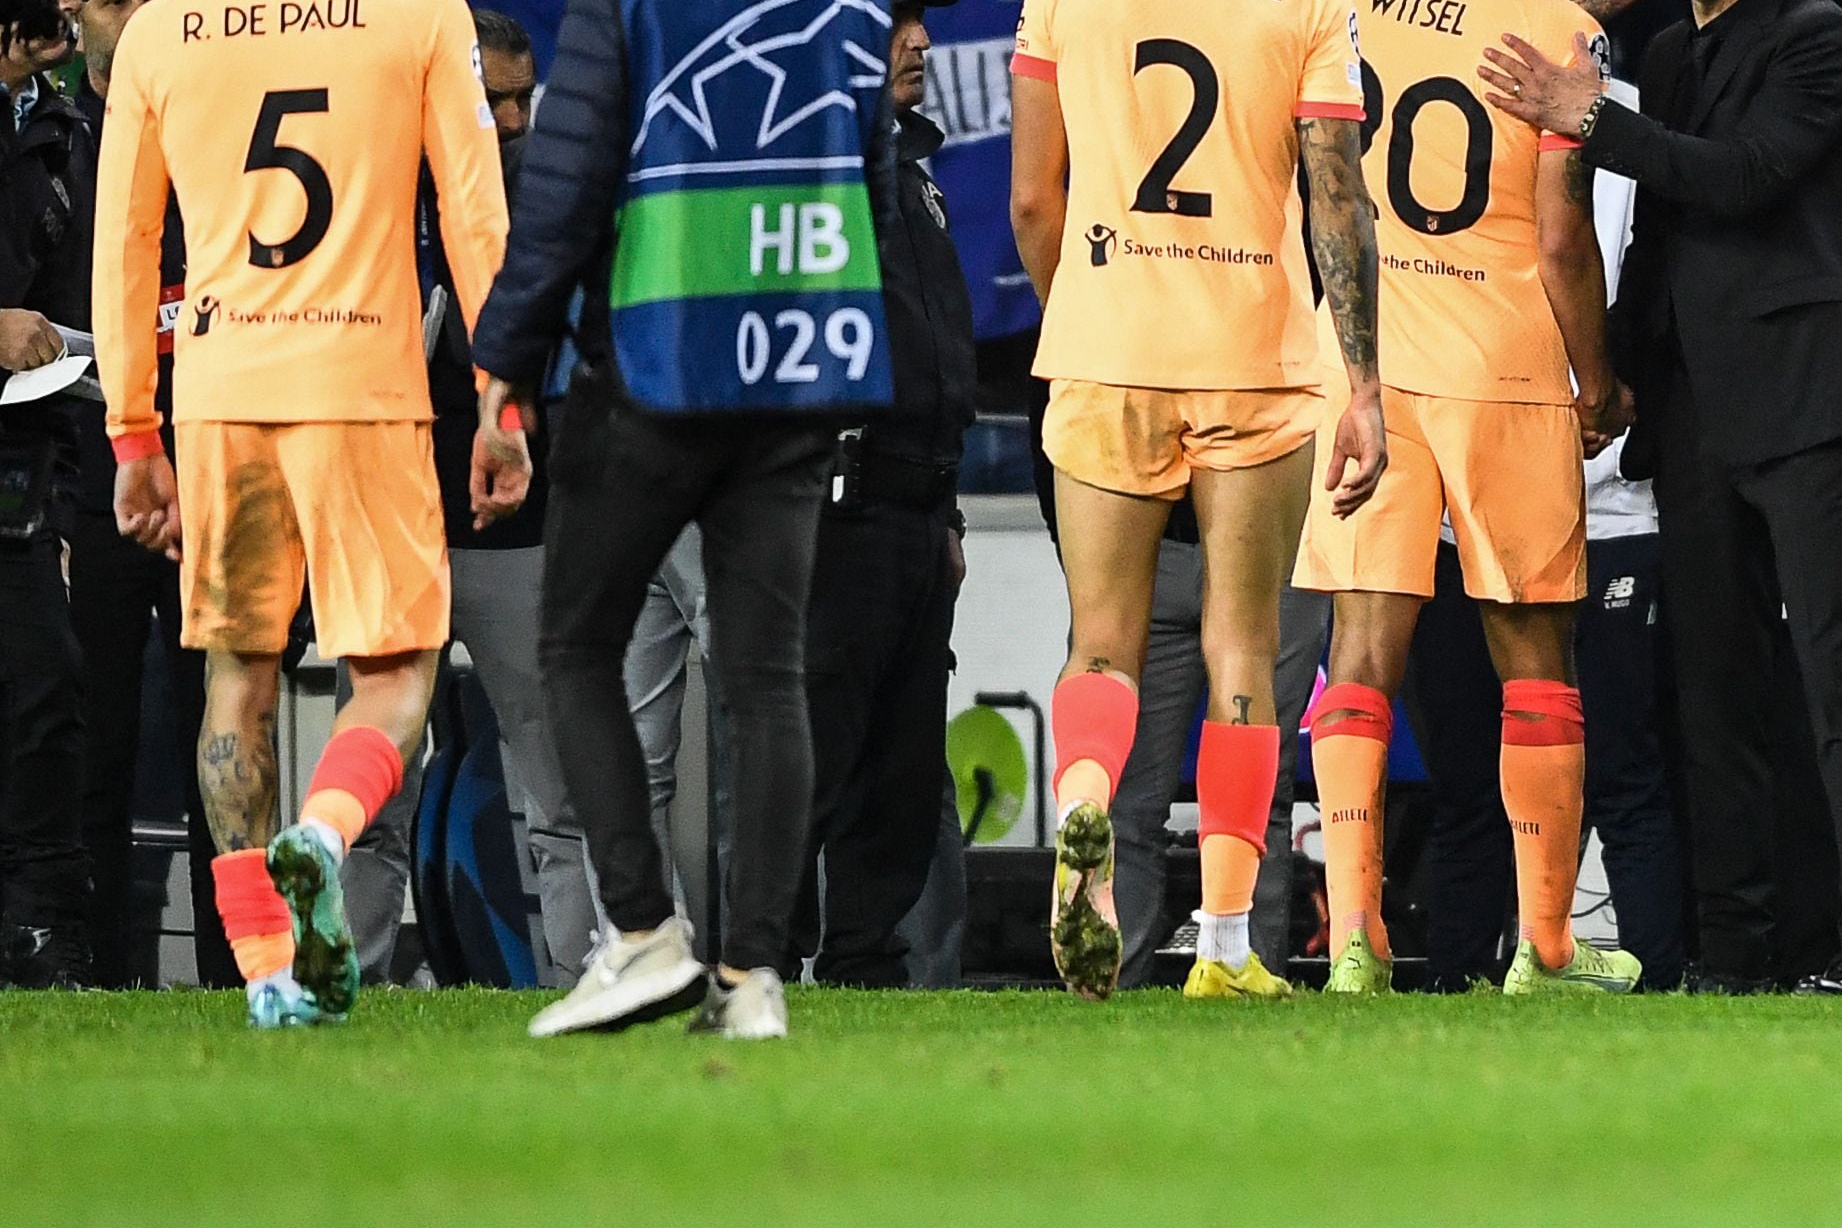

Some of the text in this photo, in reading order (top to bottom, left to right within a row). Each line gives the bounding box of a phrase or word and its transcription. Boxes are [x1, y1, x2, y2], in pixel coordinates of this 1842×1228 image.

[183, 12, 211, 44] R.
[224, 3, 266, 37] DE
[1129, 38, 1219, 217] 2
[243, 87, 333, 269] 5
[750, 202, 850, 275] HB
[1124, 239, 1274, 265] Save the Children
[1413, 259, 1485, 281] Children
[303, 310, 382, 324] Children
[736, 307, 874, 384] 029
